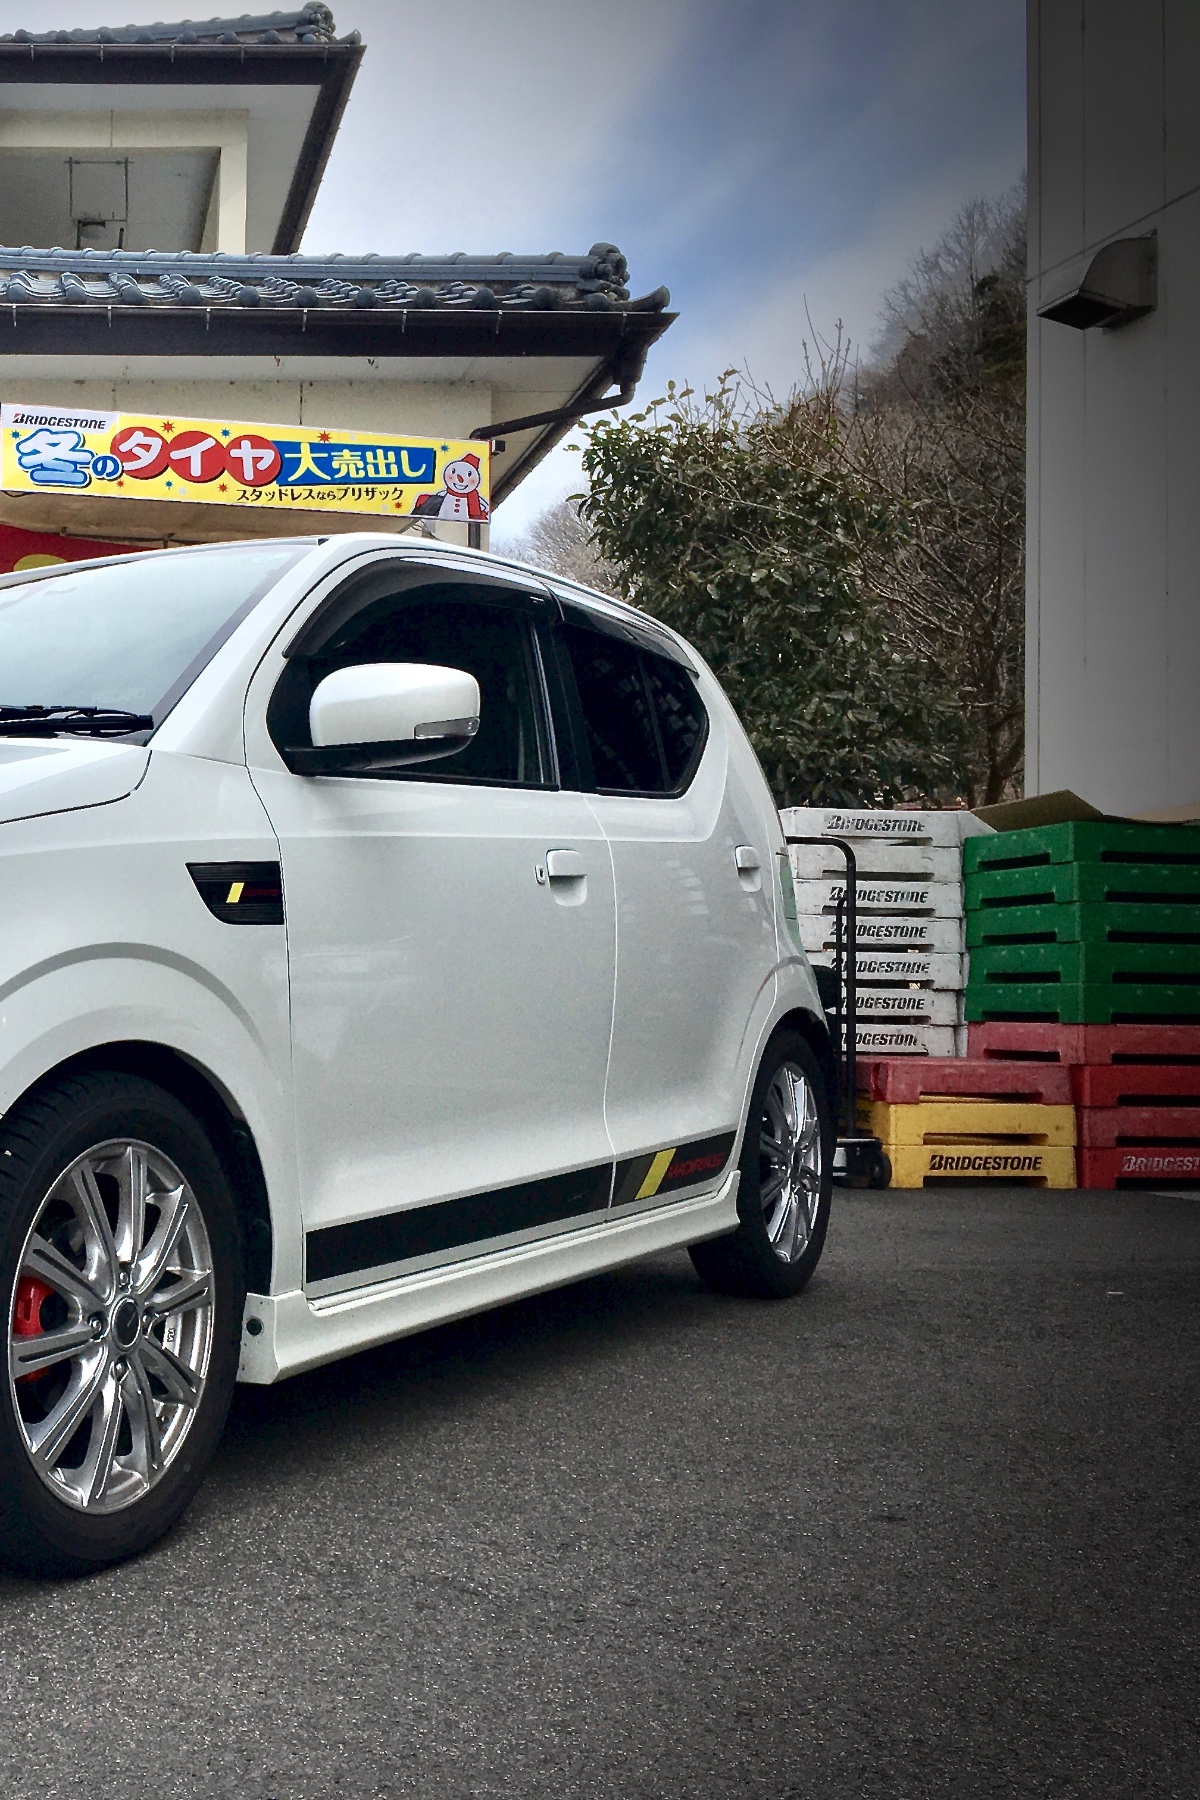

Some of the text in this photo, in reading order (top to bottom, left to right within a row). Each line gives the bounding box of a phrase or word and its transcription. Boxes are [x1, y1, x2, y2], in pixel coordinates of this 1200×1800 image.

[12, 413, 106, 429] BRIDGESTONE
[236, 487, 404, 502] スタッドレスならブリザック
[929, 1155, 1042, 1170] BRIDGESTONE
